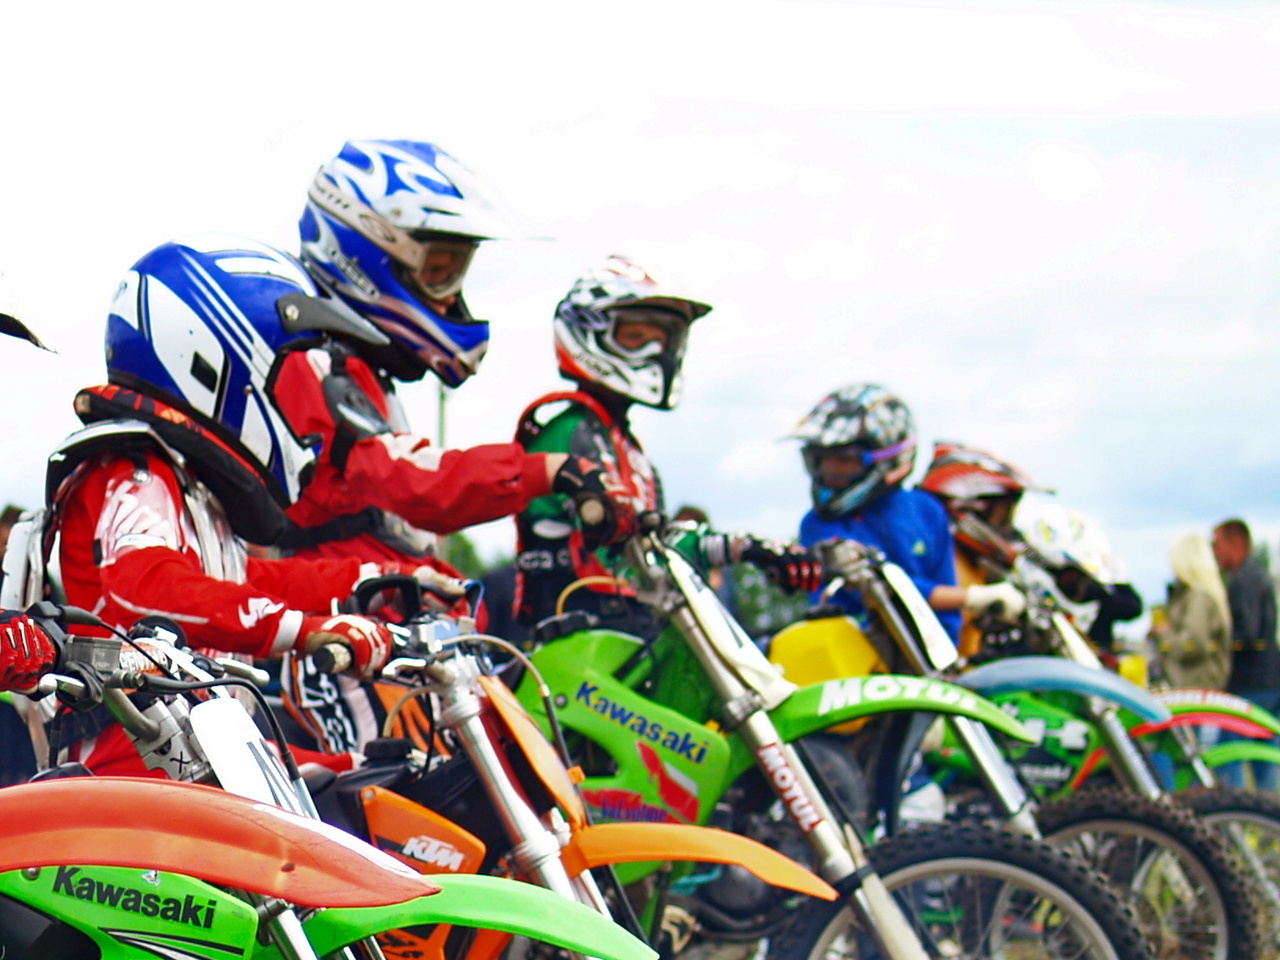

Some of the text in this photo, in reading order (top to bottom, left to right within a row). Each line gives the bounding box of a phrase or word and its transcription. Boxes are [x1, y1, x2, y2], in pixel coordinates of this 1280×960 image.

[576, 680, 711, 766] Kawasaki
[818, 676, 978, 716] MOTUL
[758, 746, 823, 832] MOTUL
[402, 835, 465, 871] KTM
[53, 866, 217, 930] Kawasaki
